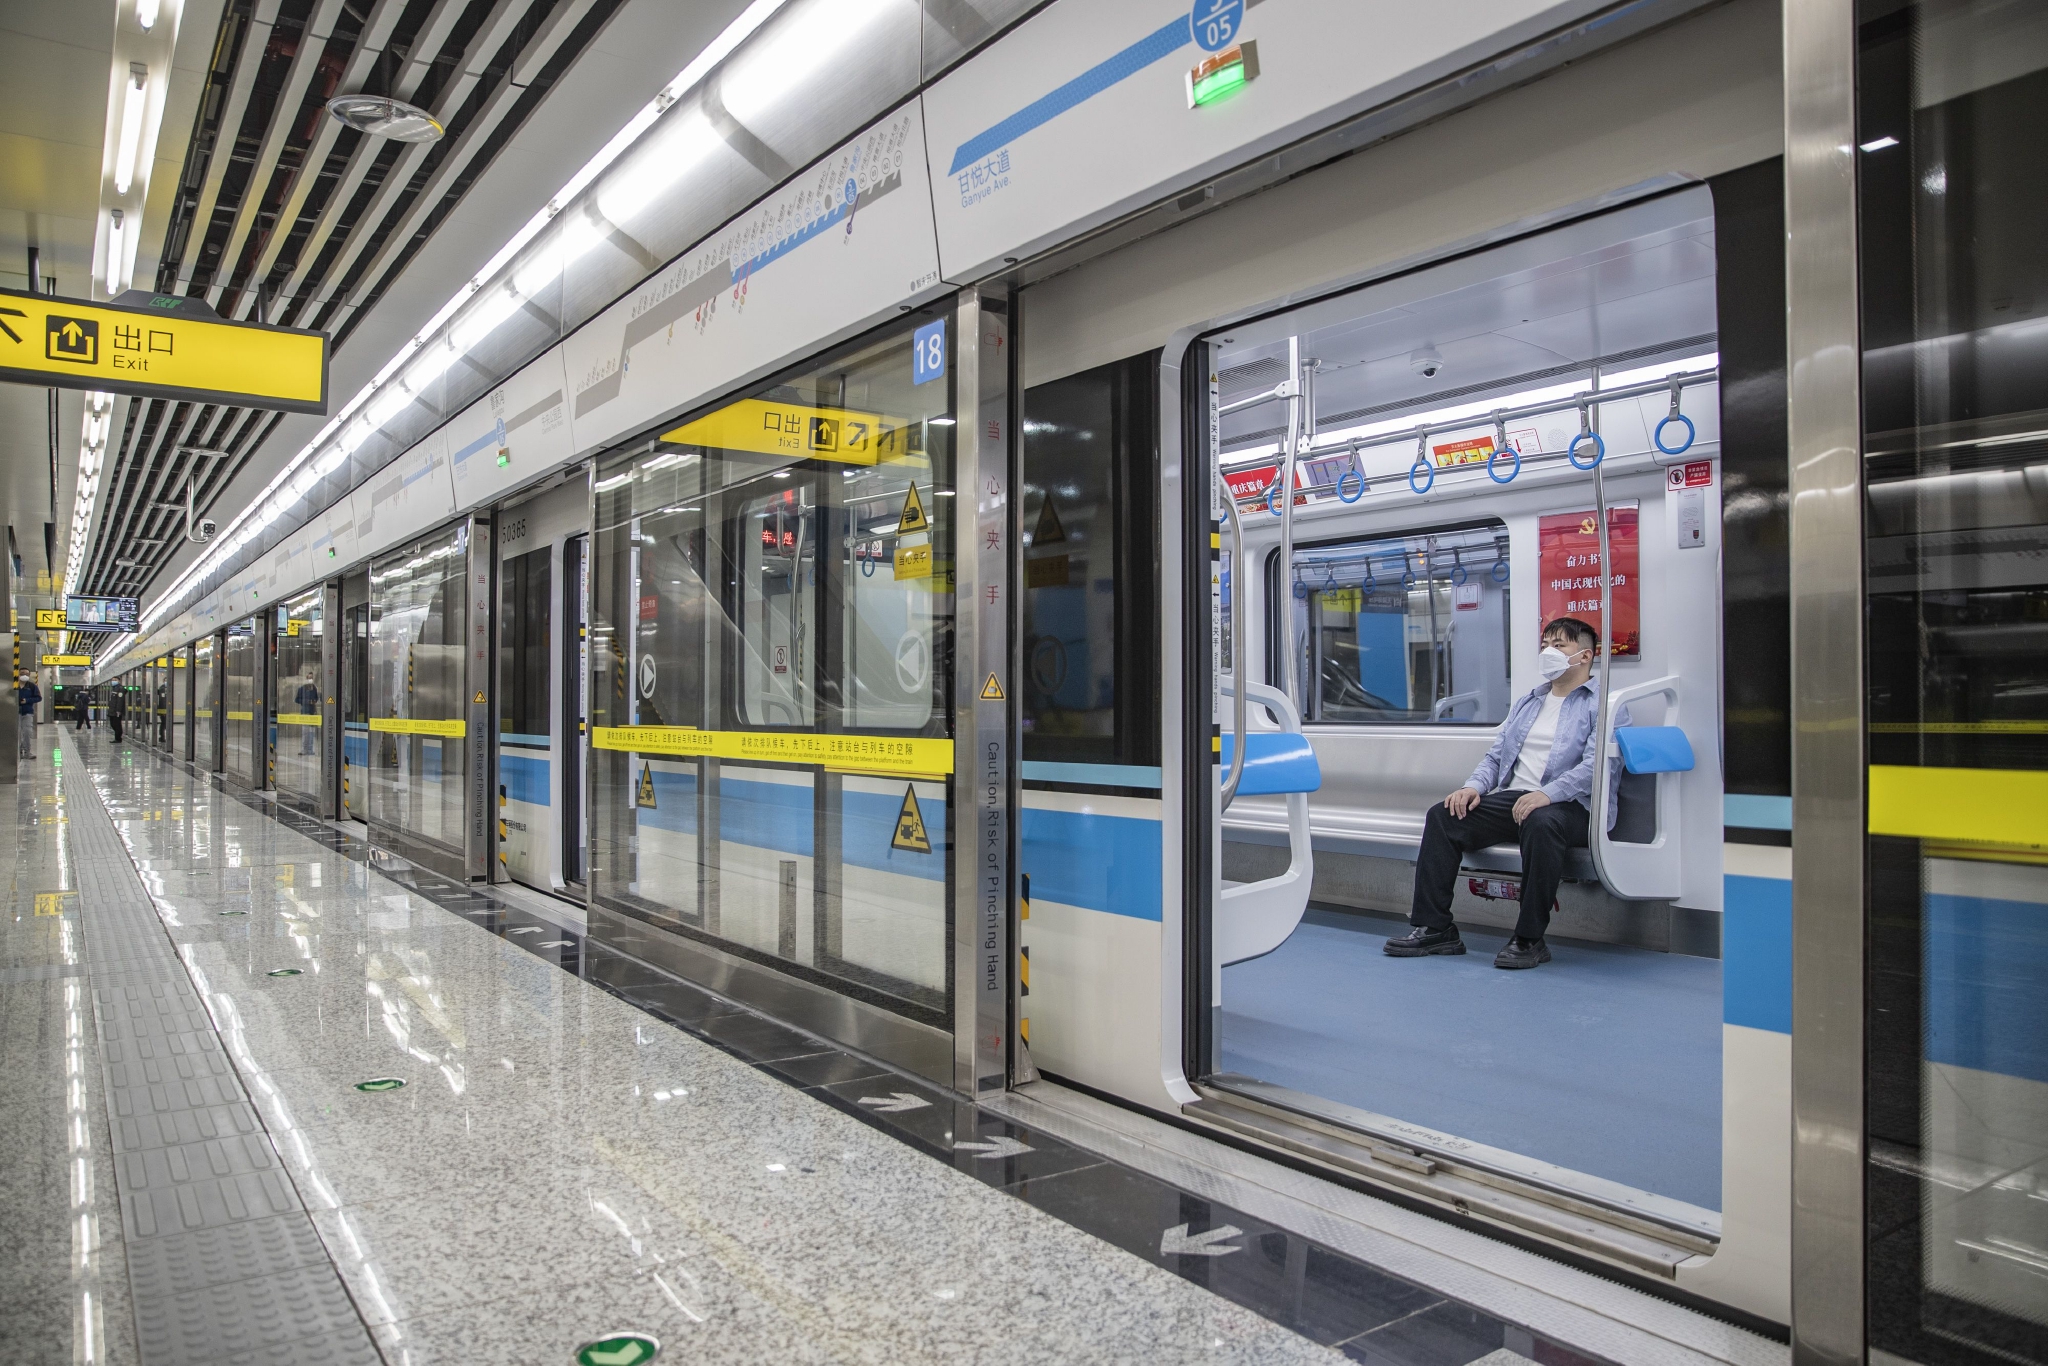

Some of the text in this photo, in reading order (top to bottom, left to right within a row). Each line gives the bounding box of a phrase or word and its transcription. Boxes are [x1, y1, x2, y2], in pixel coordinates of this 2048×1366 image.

[1206, 14, 1232, 46] 05
[958, 149, 1012, 195] 甘悦大道
[961, 176, 1012, 208] Ganyue Ave.
[114, 324, 174, 356] 出口
[916, 333, 942, 374] 18
[113, 354, 149, 372] Exit
[1231, 479, 1265, 495] 重庆篇章
[986, 420, 1000, 604] 当心夹手
[502, 518, 527, 544] 50365
[898, 551, 926, 566] 当心夹手
[476, 574, 486, 662] 当心夹手
[477, 773, 484, 782] of
[475, 784, 484, 817] Pinching
[987, 852, 998, 869] of
[984, 876, 999, 949] Pinching
[986, 955, 999, 990] Hand
